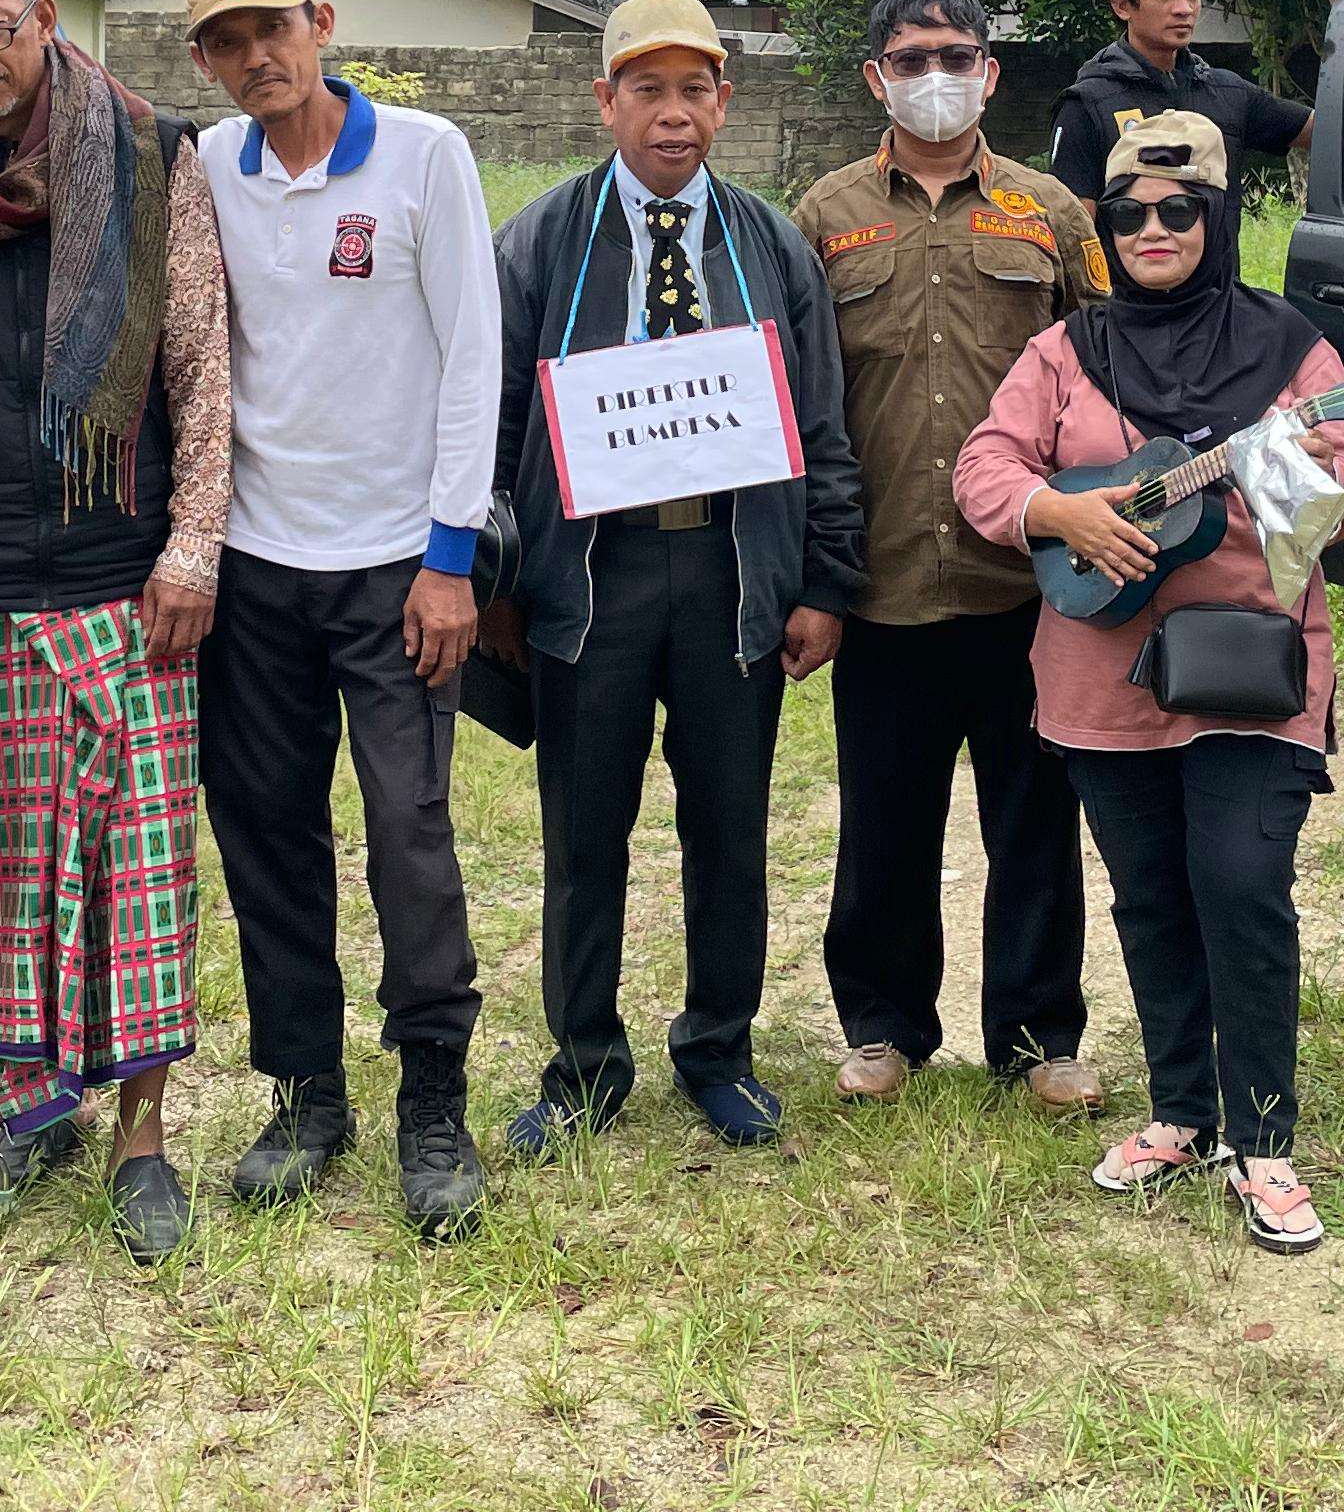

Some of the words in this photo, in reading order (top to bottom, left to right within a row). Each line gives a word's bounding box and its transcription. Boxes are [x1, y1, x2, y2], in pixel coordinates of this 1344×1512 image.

[339, 214, 376, 227] TAGANA
[829, 228, 878, 252] SARIF
[596, 373, 738, 414] DIREKTUR
[606, 409, 742, 450] BUMDESA
